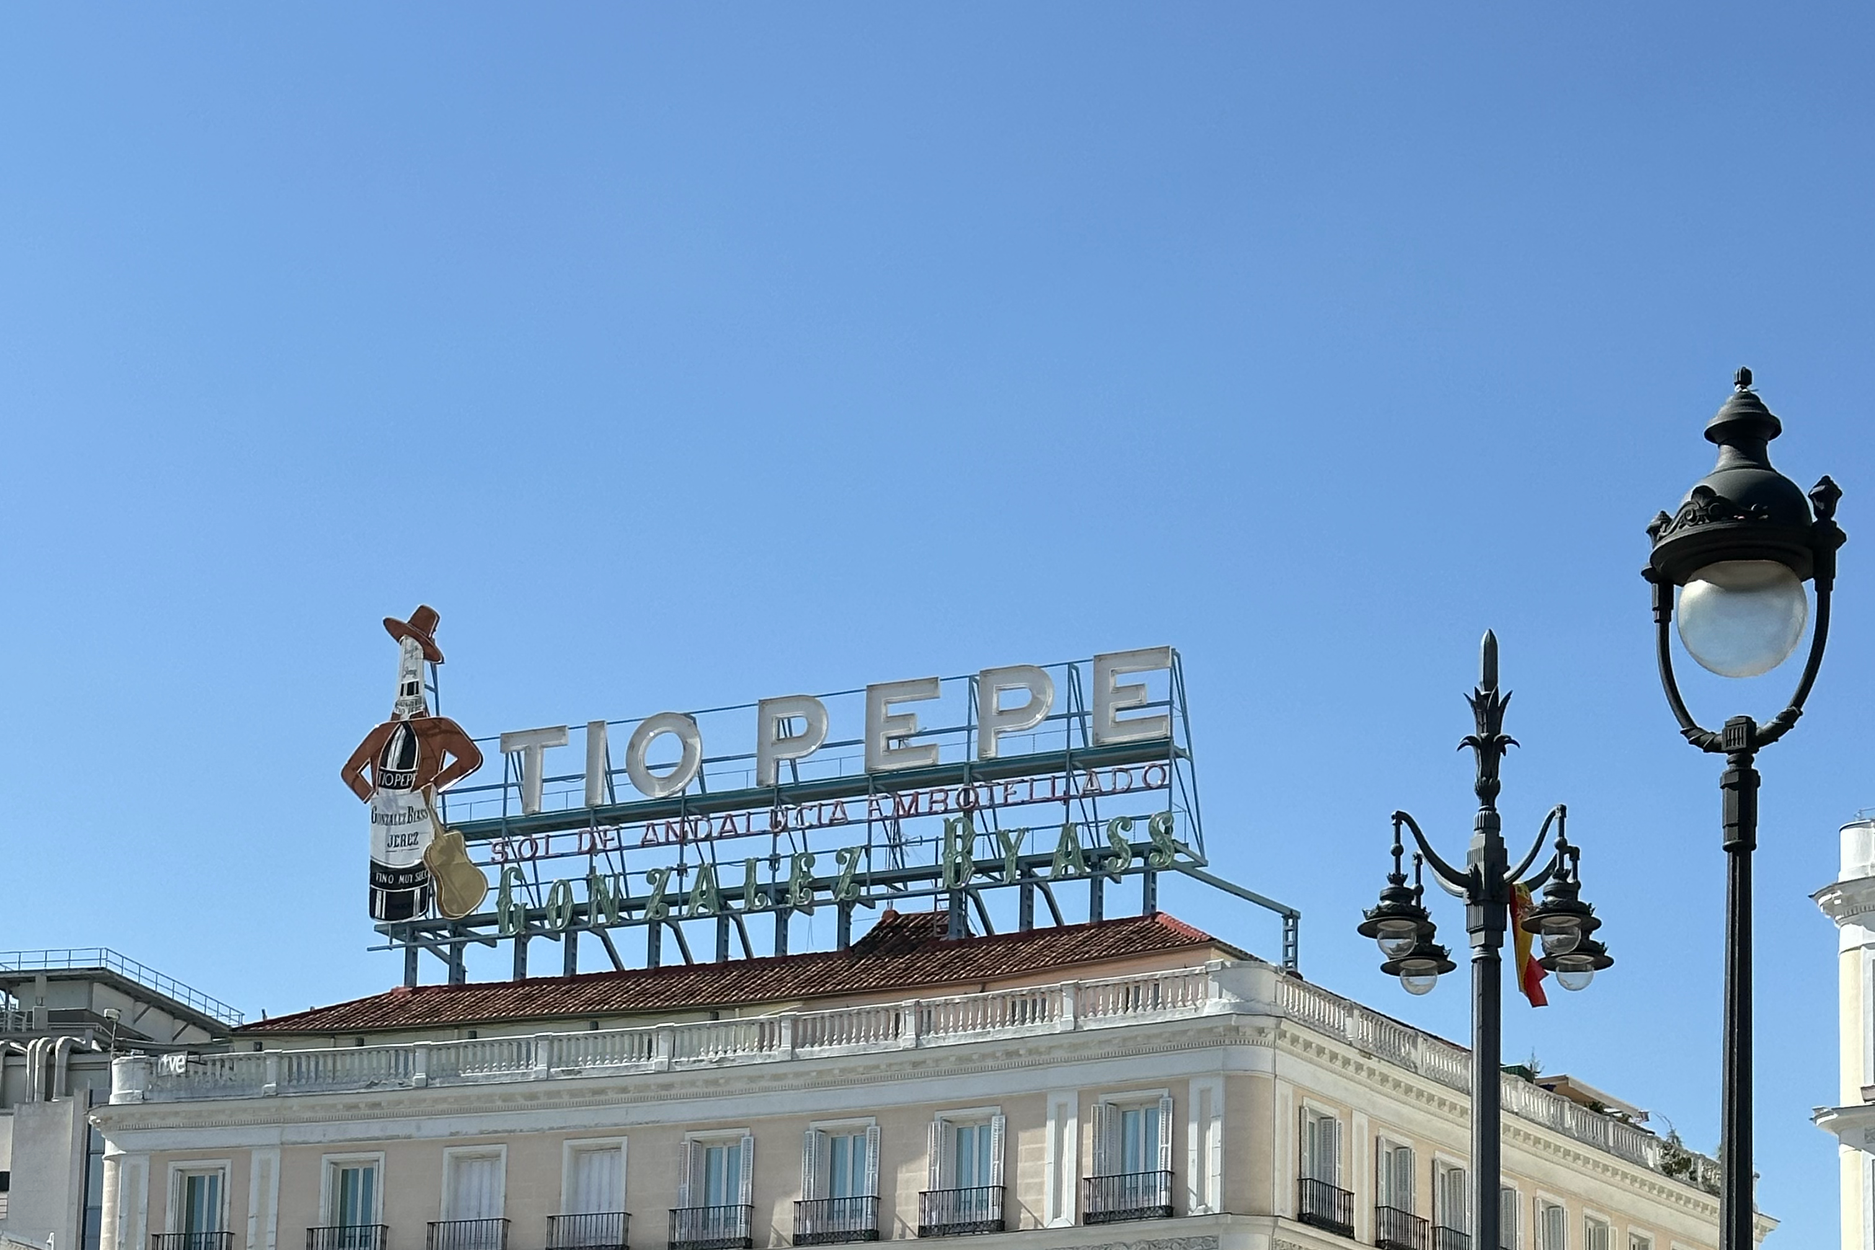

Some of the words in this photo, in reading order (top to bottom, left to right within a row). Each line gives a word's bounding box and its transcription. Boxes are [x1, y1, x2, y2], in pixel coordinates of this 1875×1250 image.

[500, 711, 701, 815] TIO
[756, 645, 1173, 788] PEPE
[371, 804, 406, 826] GONZALEZ
[490, 834, 562, 864] SOL
[577, 823, 622, 855] DE
[640, 797, 850, 848] ANDALUCIA
[387, 831, 420, 849] JEREZ
[375, 871, 395, 884] FINO
[496, 844, 866, 935] GONZALEZ
[940, 810, 1175, 890] BYASS
